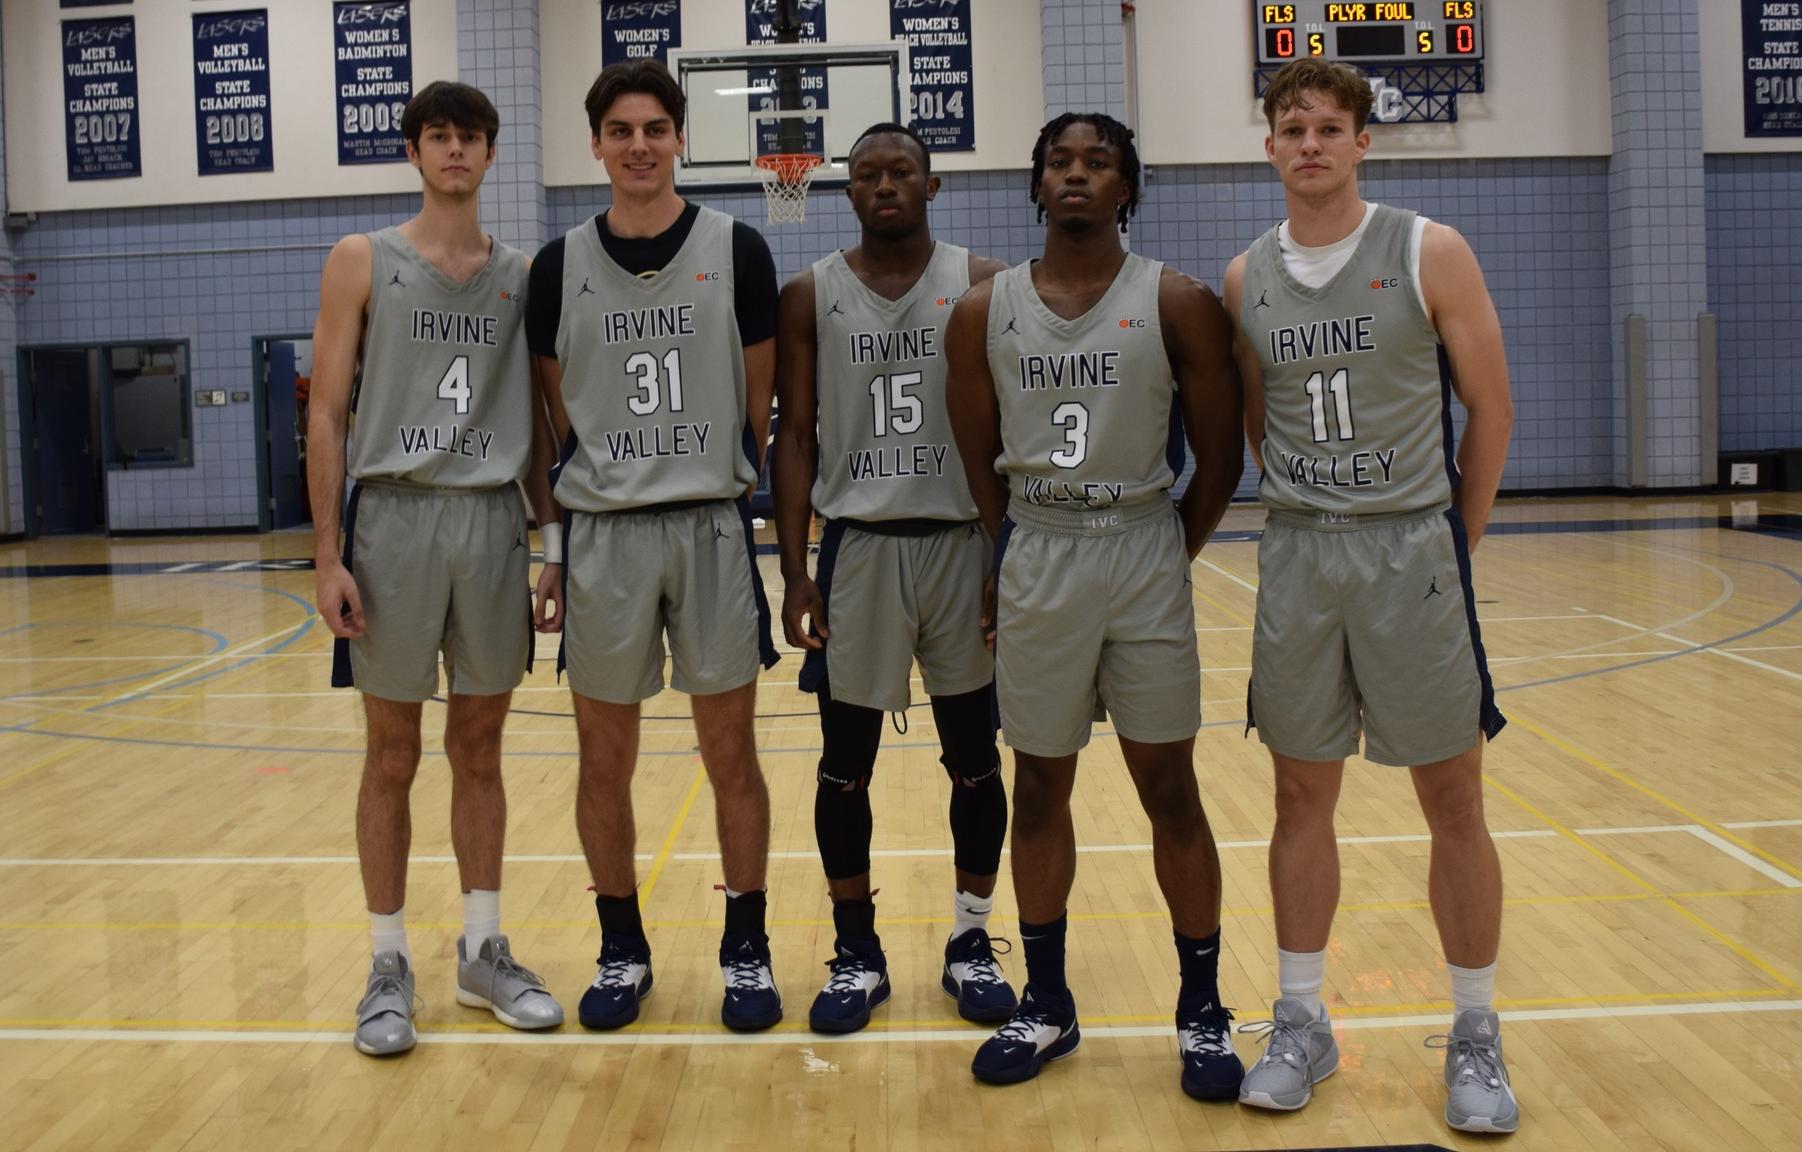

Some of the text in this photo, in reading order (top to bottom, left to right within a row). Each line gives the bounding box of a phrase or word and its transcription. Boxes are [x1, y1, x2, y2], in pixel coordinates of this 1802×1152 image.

[1266, 5, 1294, 22] FLS
[1329, 3, 1412, 21] PLYR FOUL
[1446, 2, 1473, 18] FLS
[1762, 3, 1799, 16] MEN'S
[902, 16, 959, 31] WOMEN'S
[614, 28, 670, 42] WOMEN'S
[920, 32, 968, 46] VOLLEYBALL
[1277, 30, 1293, 56] 0
[1457, 26, 1473, 52] 0
[81, 46, 116, 60] MEN'S
[213, 43, 249, 58] MEN'S
[338, 44, 407, 60] BADMINTON
[626, 44, 658, 58] GOLF
[1764, 42, 1799, 54] STATE
[68, 60, 133, 76] VOLLEYBALL
[198, 58, 265, 74] VOLLEYBALL
[914, 56, 950, 70] STATE
[1748, 57, 1802, 70] CHAMPIO
[356, 66, 392, 80] STATE
[84, 82, 118, 96] STATE
[216, 80, 250, 94] STATE
[342, 82, 409, 98] CHAMPIONS
[70, 97, 135, 113] CHAMPIONS
[200, 94, 266, 111] CHAMPIONS
[74, 113, 131, 144] 2007
[206, 113, 264, 144] 2008
[412, 308, 498, 346] IRVINE
[603, 303, 695, 344] IRVINE
[850, 326, 936, 365] IRVINE
[1270, 314, 1376, 364] IRVINE
[1019, 351, 1120, 392] IRVINE
[436, 354, 472, 416] 4
[624, 348, 684, 416] 31
[868, 370, 924, 438] 15
[1304, 367, 1356, 444] 11
[400, 424, 494, 461] VALLEY
[605, 422, 711, 462] VALLEY
[1049, 402, 1090, 469] 3
[848, 445, 948, 481] VALLEY
[1281, 448, 1396, 488] VALLEY
[1092, 514, 1119, 528] IVC
